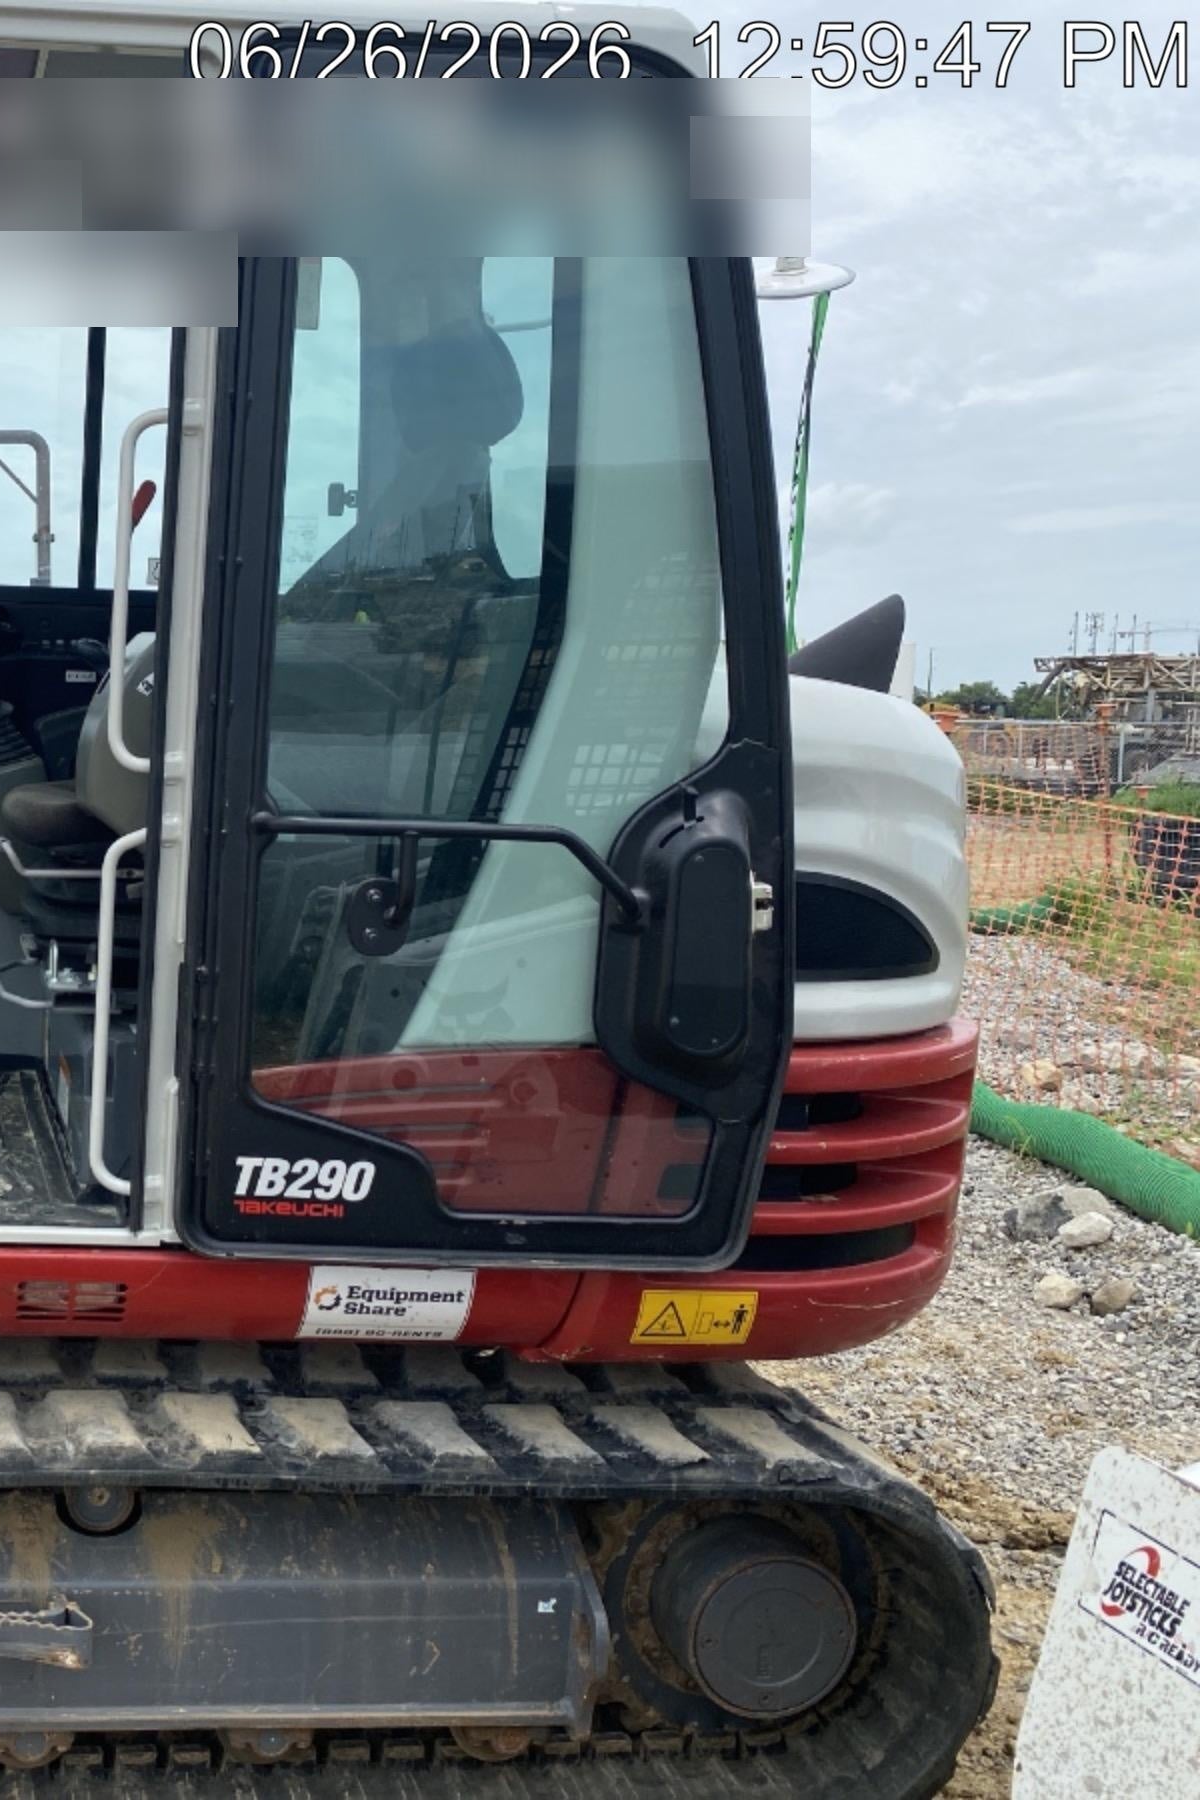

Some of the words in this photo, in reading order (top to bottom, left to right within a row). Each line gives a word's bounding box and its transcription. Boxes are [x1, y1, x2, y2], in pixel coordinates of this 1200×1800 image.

[234, 1155, 377, 1202] TB290
[343, 1302, 407, 1317] Share
[346, 1285, 465, 1305] Equipment
[1102, 1577, 1182, 1638] JOYSTICKS
[1113, 1560, 1191, 1618] SELECTABLE
